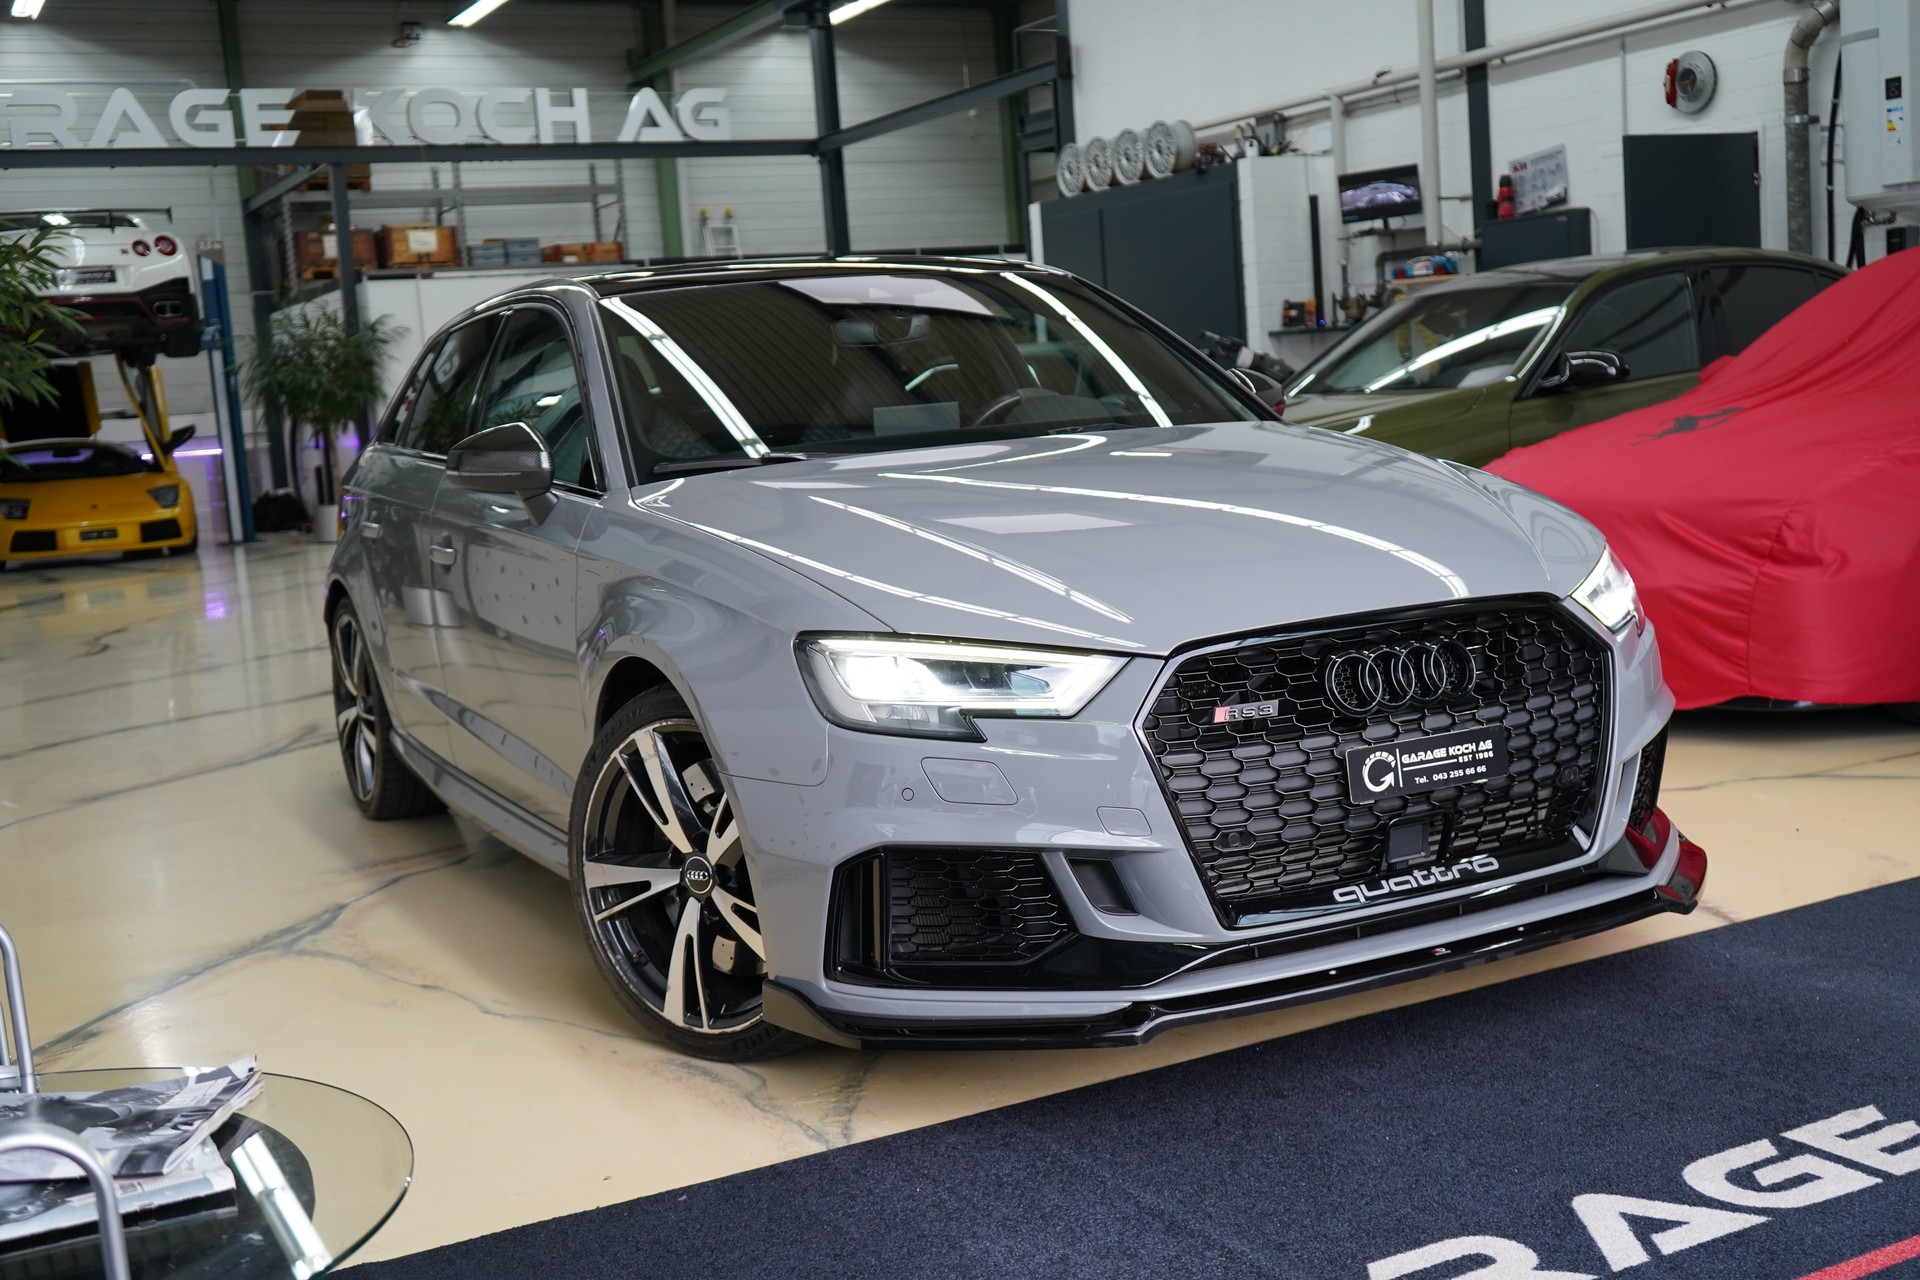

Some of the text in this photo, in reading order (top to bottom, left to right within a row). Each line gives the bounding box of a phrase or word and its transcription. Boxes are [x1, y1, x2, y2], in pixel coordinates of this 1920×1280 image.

[4, 87, 732, 148] RAGE KOCH AG
[1224, 704, 1274, 720] RS3
[1401, 739, 1493, 764] GARAGE KOCH AG
[1458, 750, 1494, 763] EST 1986
[1414, 765, 1487, 784] Tel. 043 255 66 66
[1333, 857, 1500, 903] quattro
